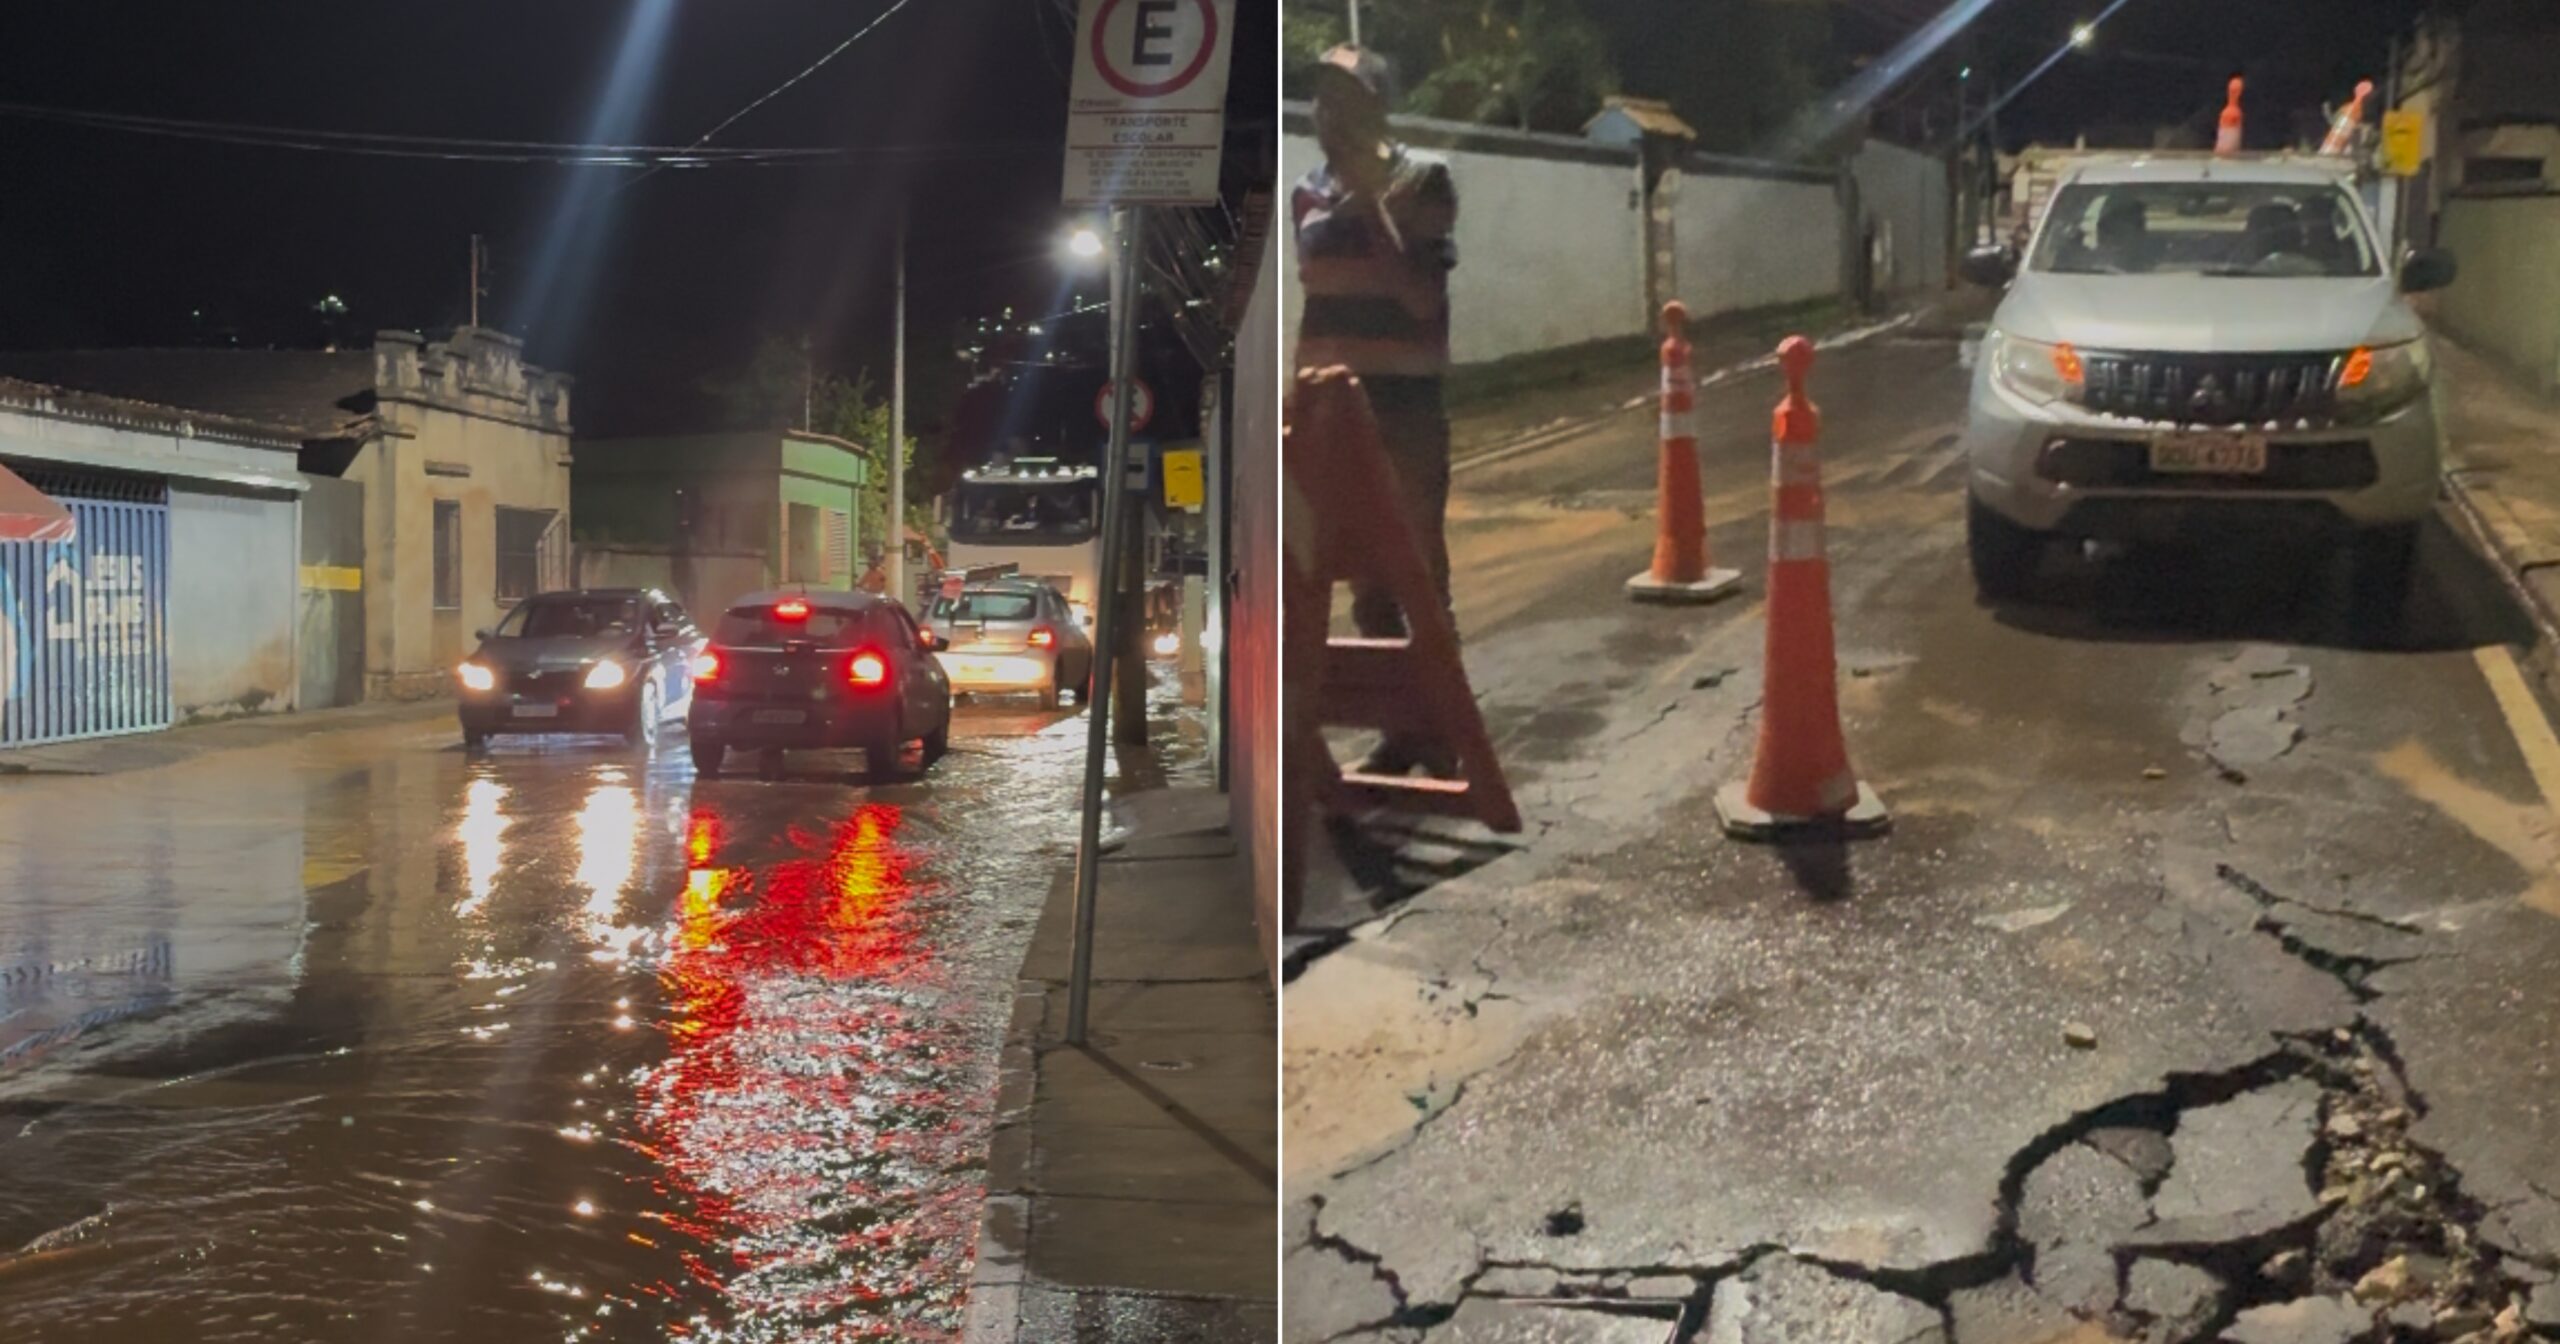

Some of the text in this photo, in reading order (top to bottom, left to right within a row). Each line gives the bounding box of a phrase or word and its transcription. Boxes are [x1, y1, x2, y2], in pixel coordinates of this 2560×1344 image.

[1132, 1, 1178, 65] E
[1103, 116, 1188, 128] TRANSPORTE
[1112, 131, 1174, 144] ESCOLAR
